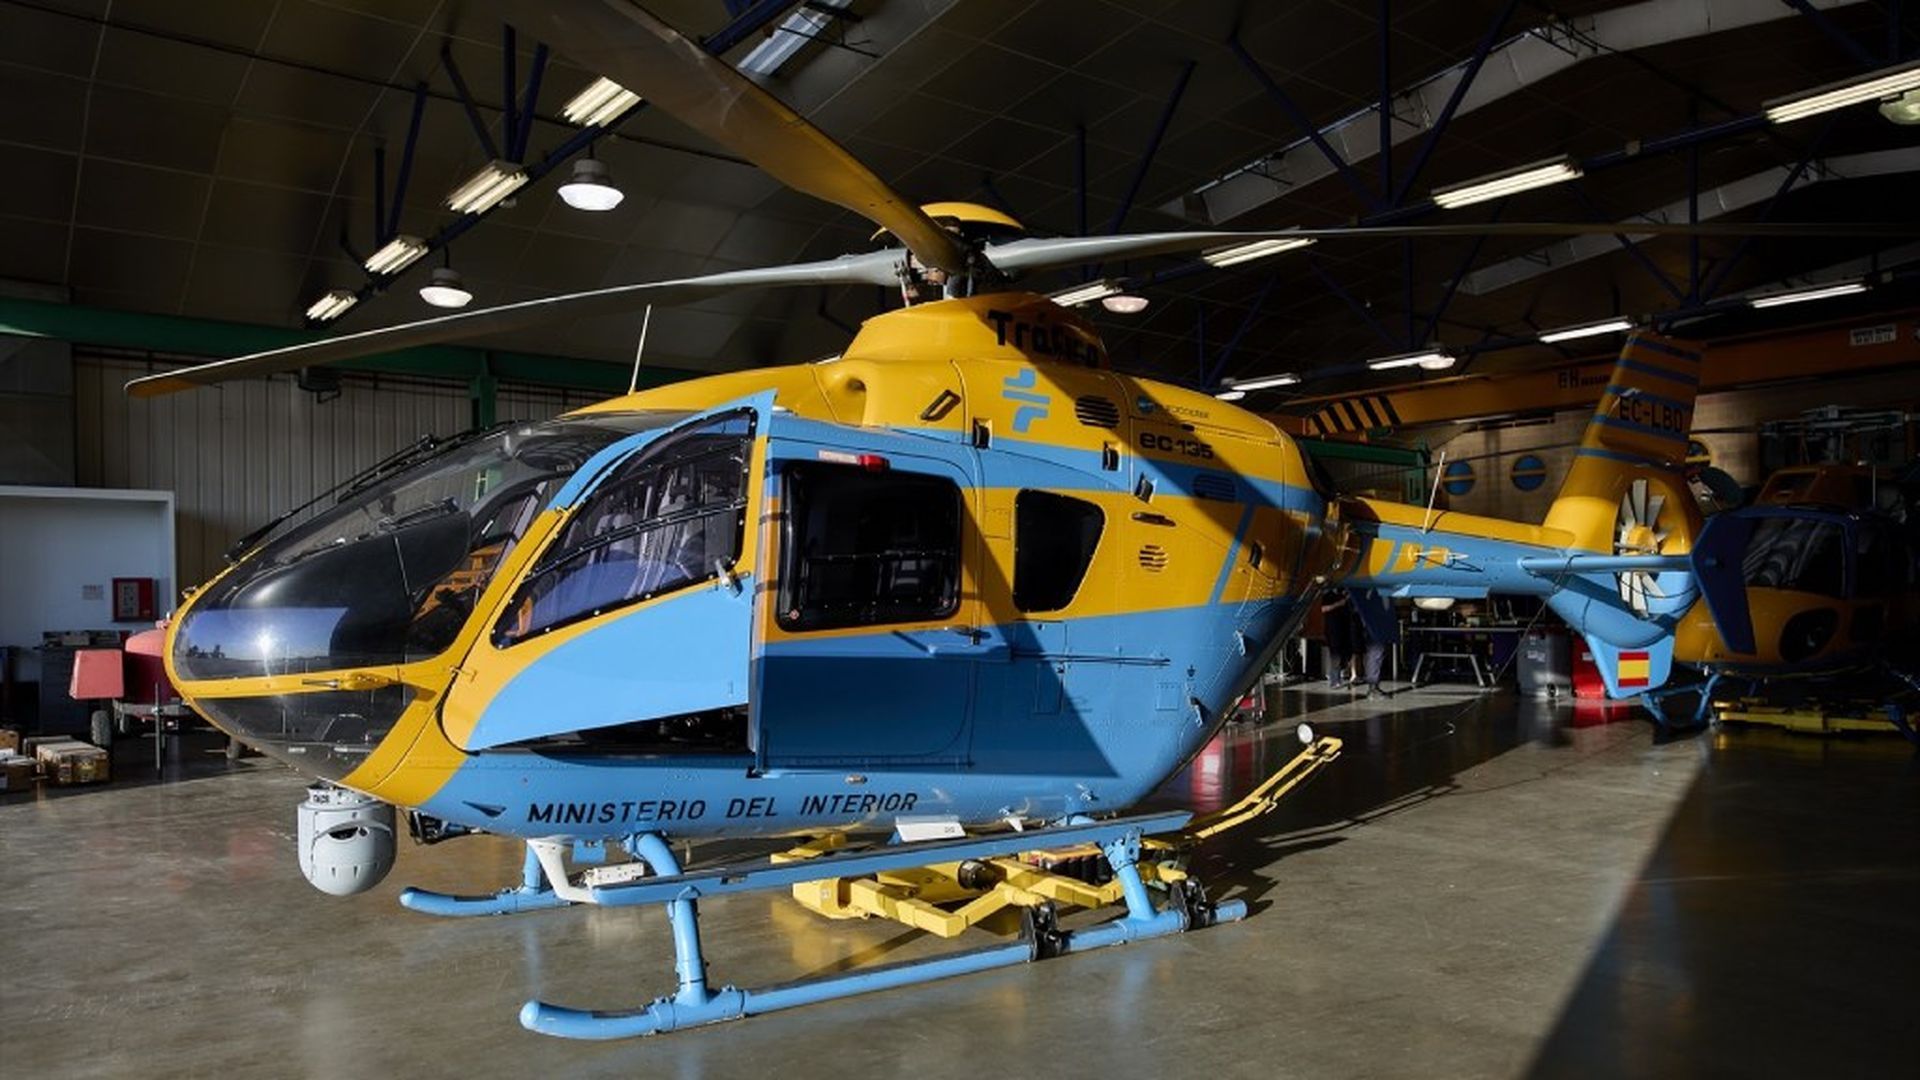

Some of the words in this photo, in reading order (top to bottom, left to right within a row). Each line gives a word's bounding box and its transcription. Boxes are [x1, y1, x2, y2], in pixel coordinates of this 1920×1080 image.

[528, 800, 706, 824] MINISTERIO
[726, 798, 778, 819] DEL
[802, 793, 918, 816] INTERIOR
